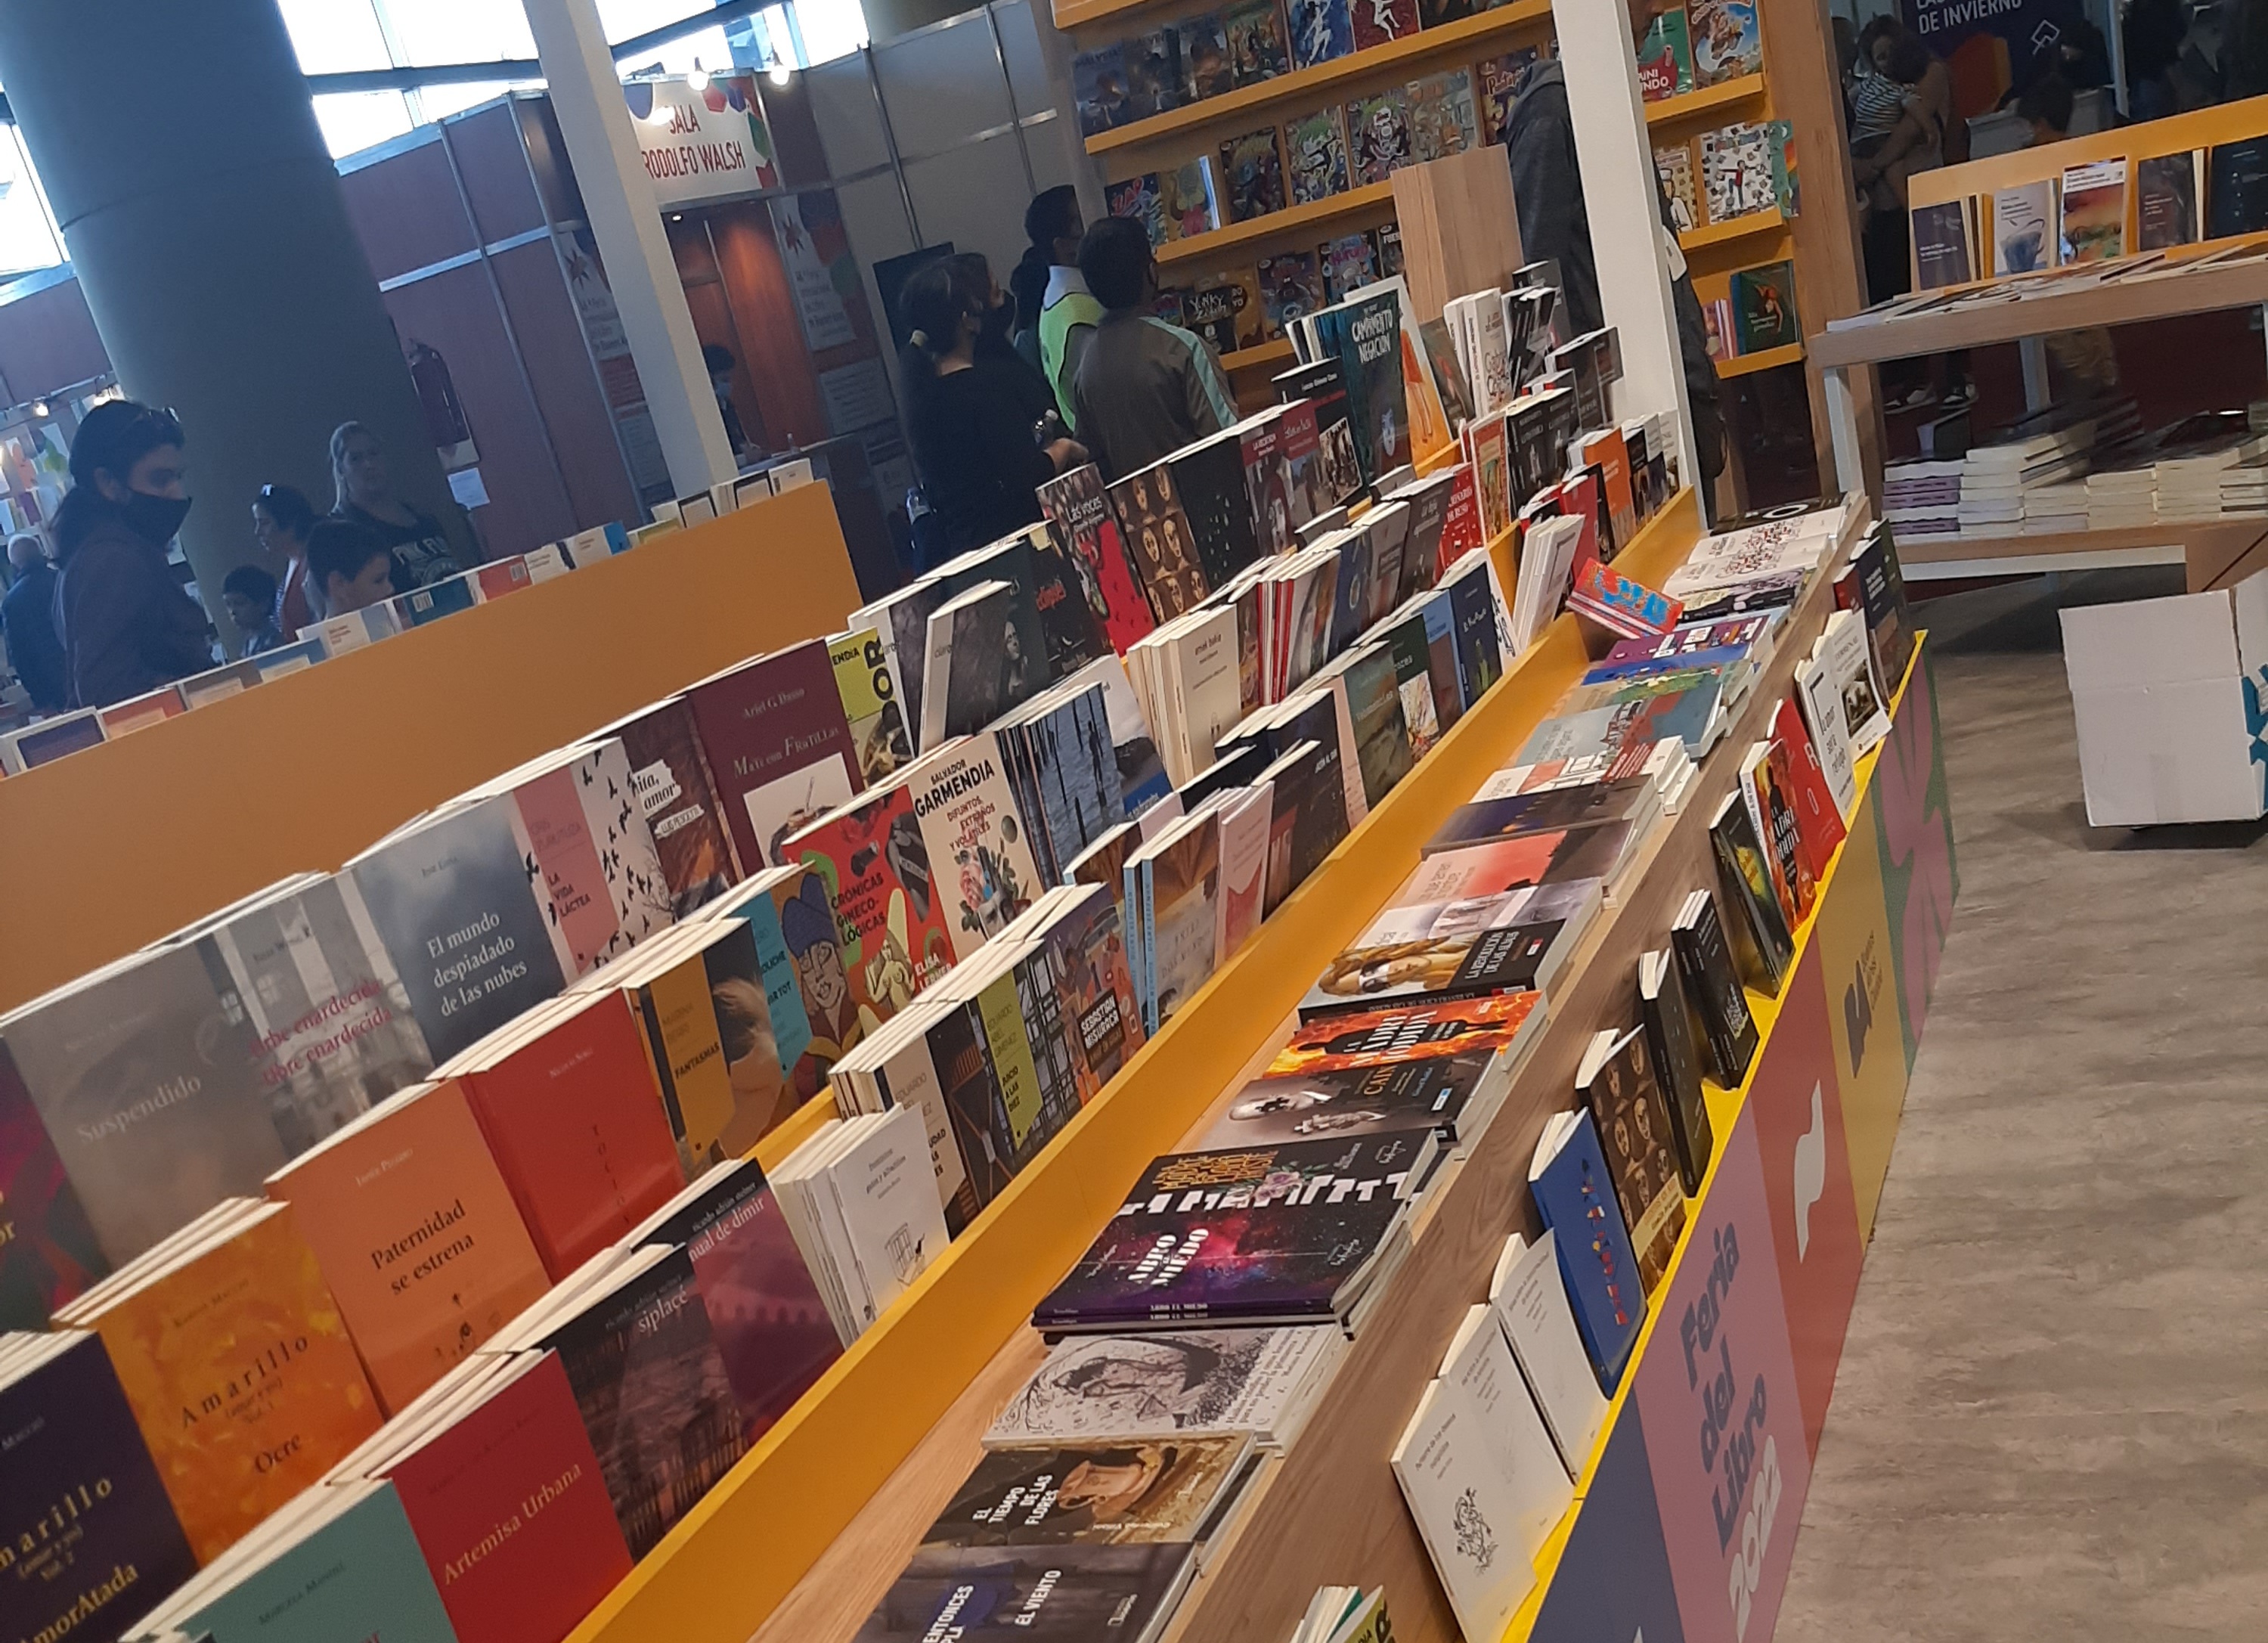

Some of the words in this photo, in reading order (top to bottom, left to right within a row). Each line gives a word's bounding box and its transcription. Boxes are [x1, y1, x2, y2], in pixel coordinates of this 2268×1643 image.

[1919, 11, 1940, 34] DE
[1943, 0, 2022, 28] INVIERNO
[642, 145, 699, 180] RODOLFO
[697, 141, 745, 173] WALSH
[914, 759, 996, 818] GARMENDIA
[930, 758, 967, 786] SALVADOR
[644, 782, 676, 811] amor
[547, 873, 561, 886] LA
[554, 884, 575, 901] VIDA
[426, 936, 445, 959] El
[446, 912, 500, 949] mundo
[433, 936, 515, 989] despiadado
[441, 997, 459, 1017] de
[458, 986, 482, 1006] las
[484, 960, 528, 994] nubes
[305, 1006, 392, 1062] enardecida
[674, 1041, 720, 1080] FANTASMAS
[79, 1074, 202, 1146] Suspendido
[370, 1198, 466, 1270] Paternidad
[715, 1220, 732, 1241] de
[389, 1275, 409, 1296] se
[413, 1233, 476, 1280] estrena
[1680, 1222, 1740, 1393] Feria
[181, 1336, 308, 1428] Amarillo
[1699, 1332, 1737, 1474] del
[254, 1434, 300, 1474] Ocre
[1711, 1372, 1767, 1559] Libro
[972, 1507, 992, 1523] EL
[988, 1486, 1026, 1524] TIEMPO
[1019, 1490, 1039, 1508] DE
[1024, 1489, 1060, 1526] FLORES
[442, 1517, 522, 1587] Artemisa
[522, 1462, 581, 1518] Urbana
[1023, 1569, 1062, 1611] VIENTO
[1015, 1610, 1036, 1627] EL
